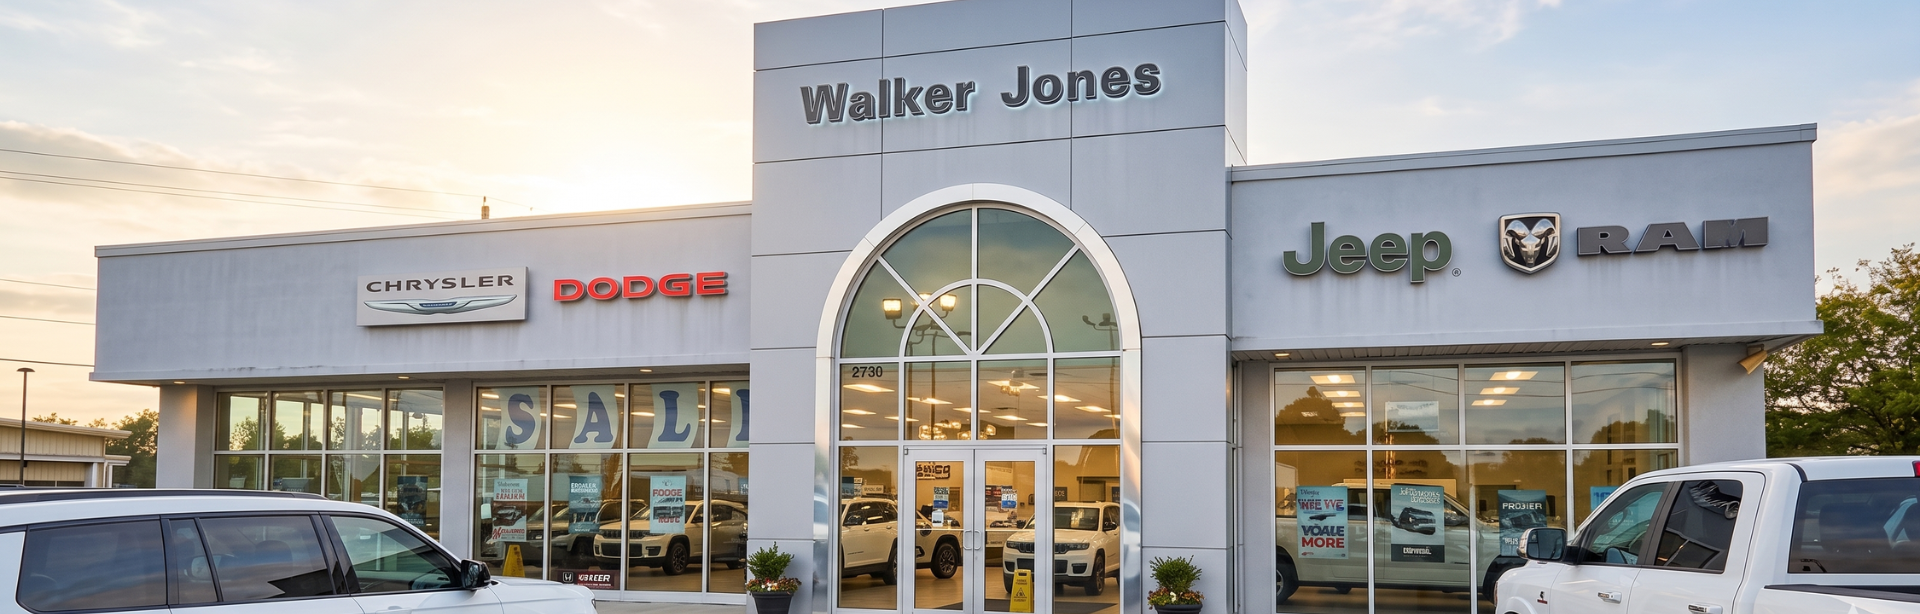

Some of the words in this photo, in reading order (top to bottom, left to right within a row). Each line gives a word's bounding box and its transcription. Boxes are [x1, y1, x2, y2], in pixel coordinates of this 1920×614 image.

[800, 77, 976, 124] Walker
[1000, 62, 1161, 108] Jones
[1577, 216, 1769, 256] RAM
[1282, 221, 1453, 283] Jeep
[365, 274, 515, 292] CHRYSLER
[553, 271, 728, 302] DODGE
[852, 365, 883, 378] 2730
[1301, 536, 1345, 548] MORE
